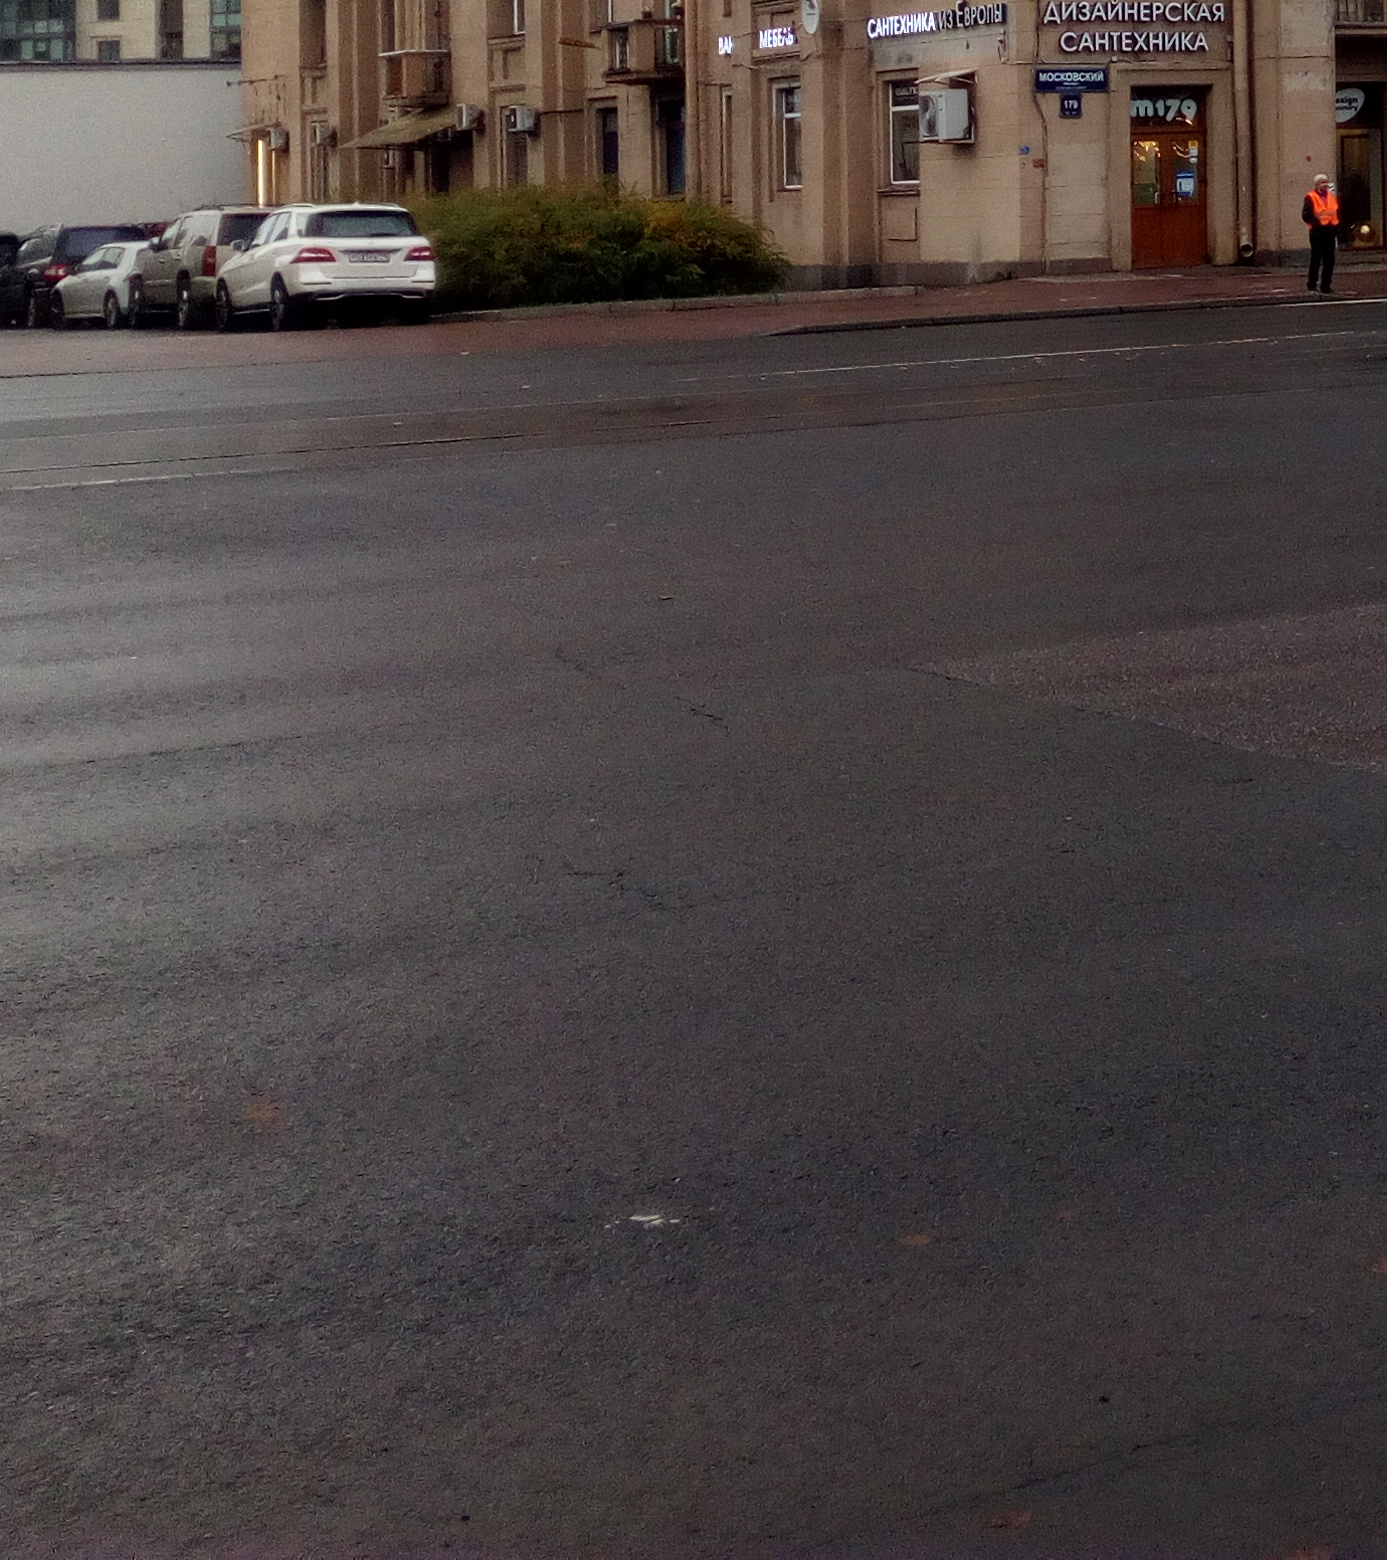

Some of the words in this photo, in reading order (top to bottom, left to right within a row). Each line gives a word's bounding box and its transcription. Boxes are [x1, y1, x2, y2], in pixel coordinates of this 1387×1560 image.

[1043, 0, 1225, 24] ДИЗАЙНЕРСКАЯ
[867, 11, 936, 38] САНТЕХНИКА
[1060, 31, 1209, 52] САНТЕХНИКА
[1039, 70, 1104, 82] МОСКОВСКИЙ
